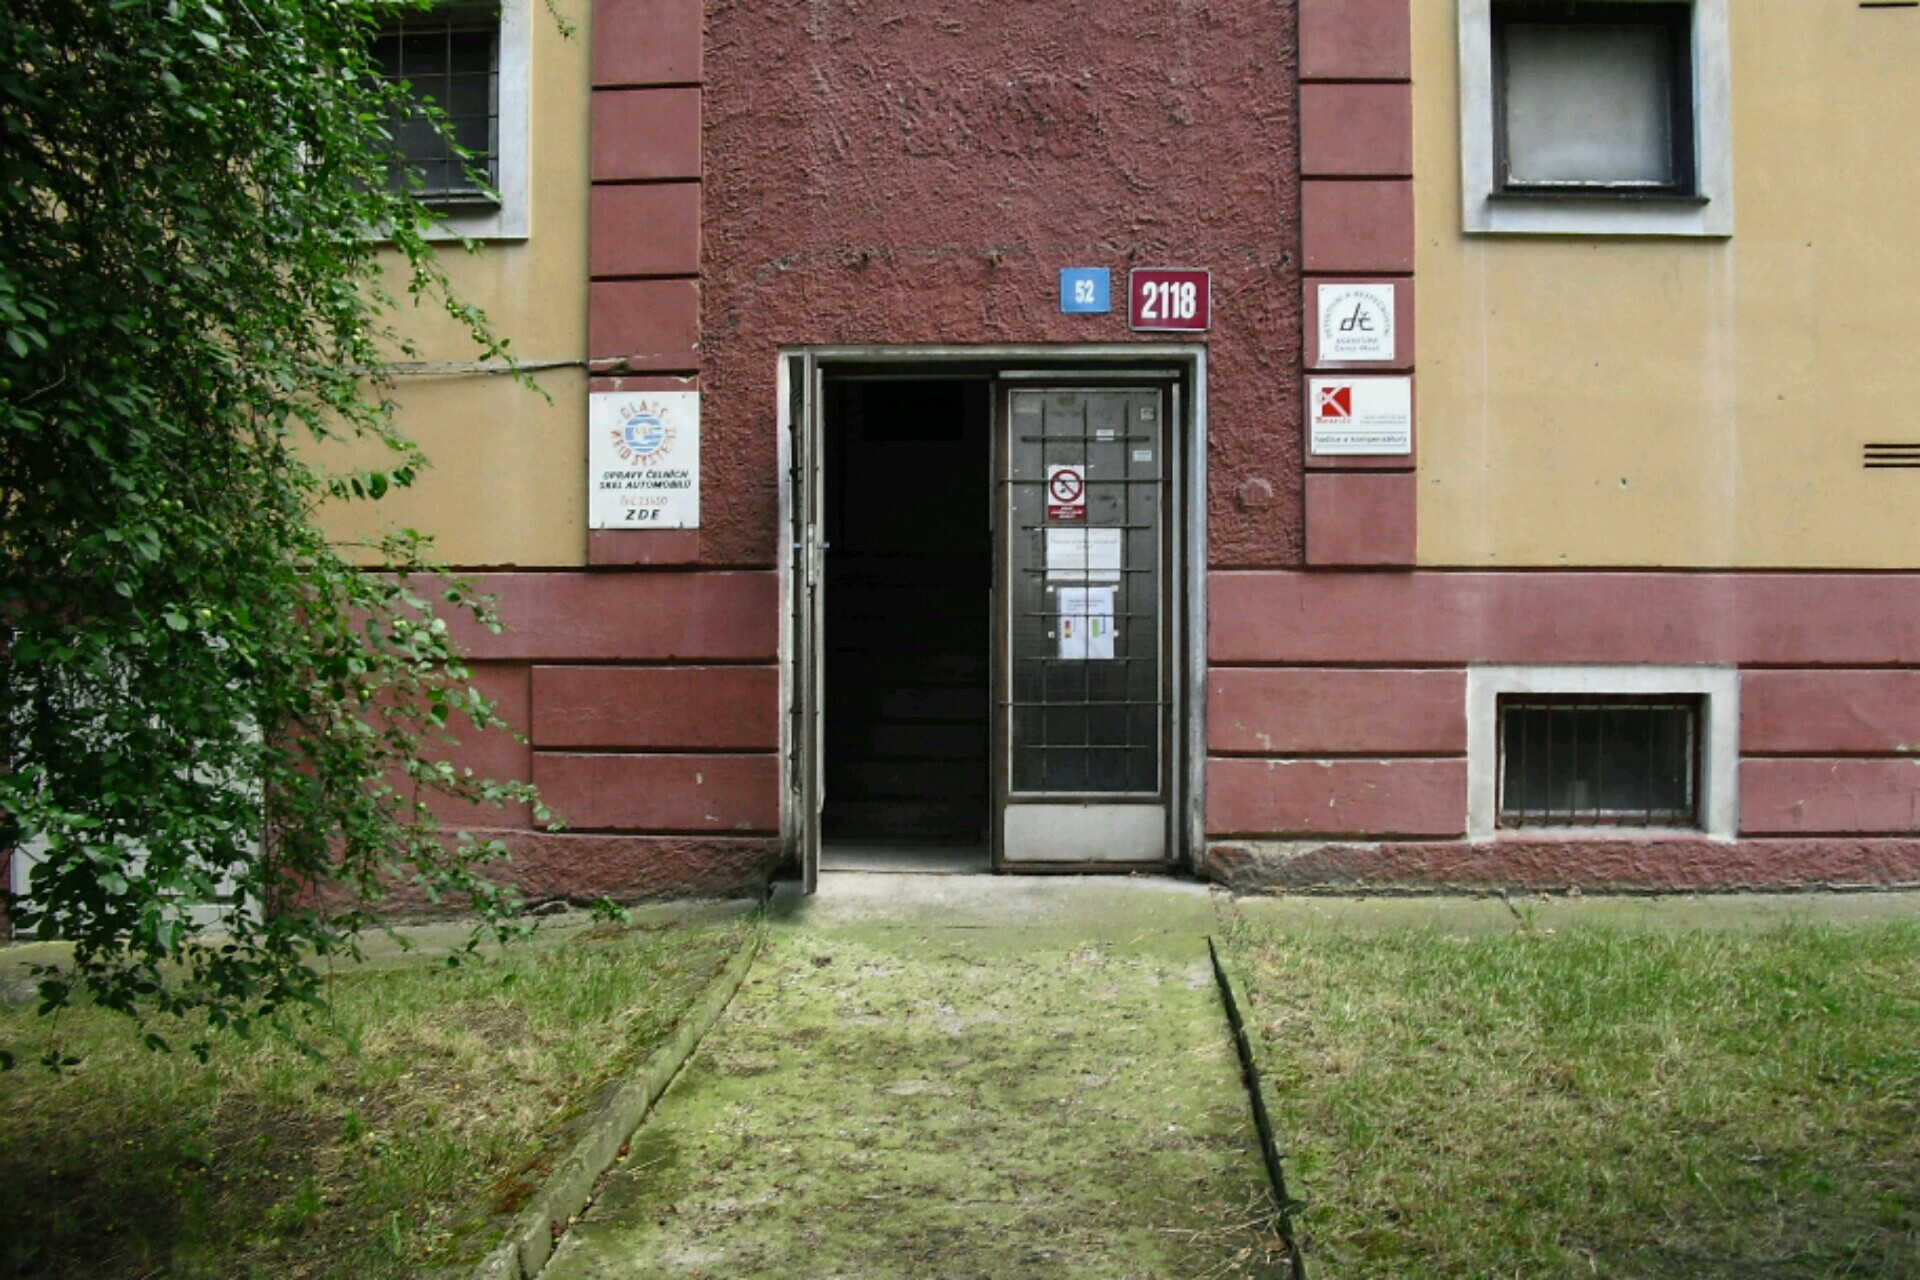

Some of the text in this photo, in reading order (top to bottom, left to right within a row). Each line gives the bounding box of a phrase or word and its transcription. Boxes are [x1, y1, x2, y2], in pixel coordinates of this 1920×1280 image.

[1075, 279, 1095, 304] 52
[1141, 281, 1197, 319] 2118
[603, 471, 643, 480] OPRAVY
[600, 481, 622, 489] SKEL
[625, 509, 660, 521] ZDE
